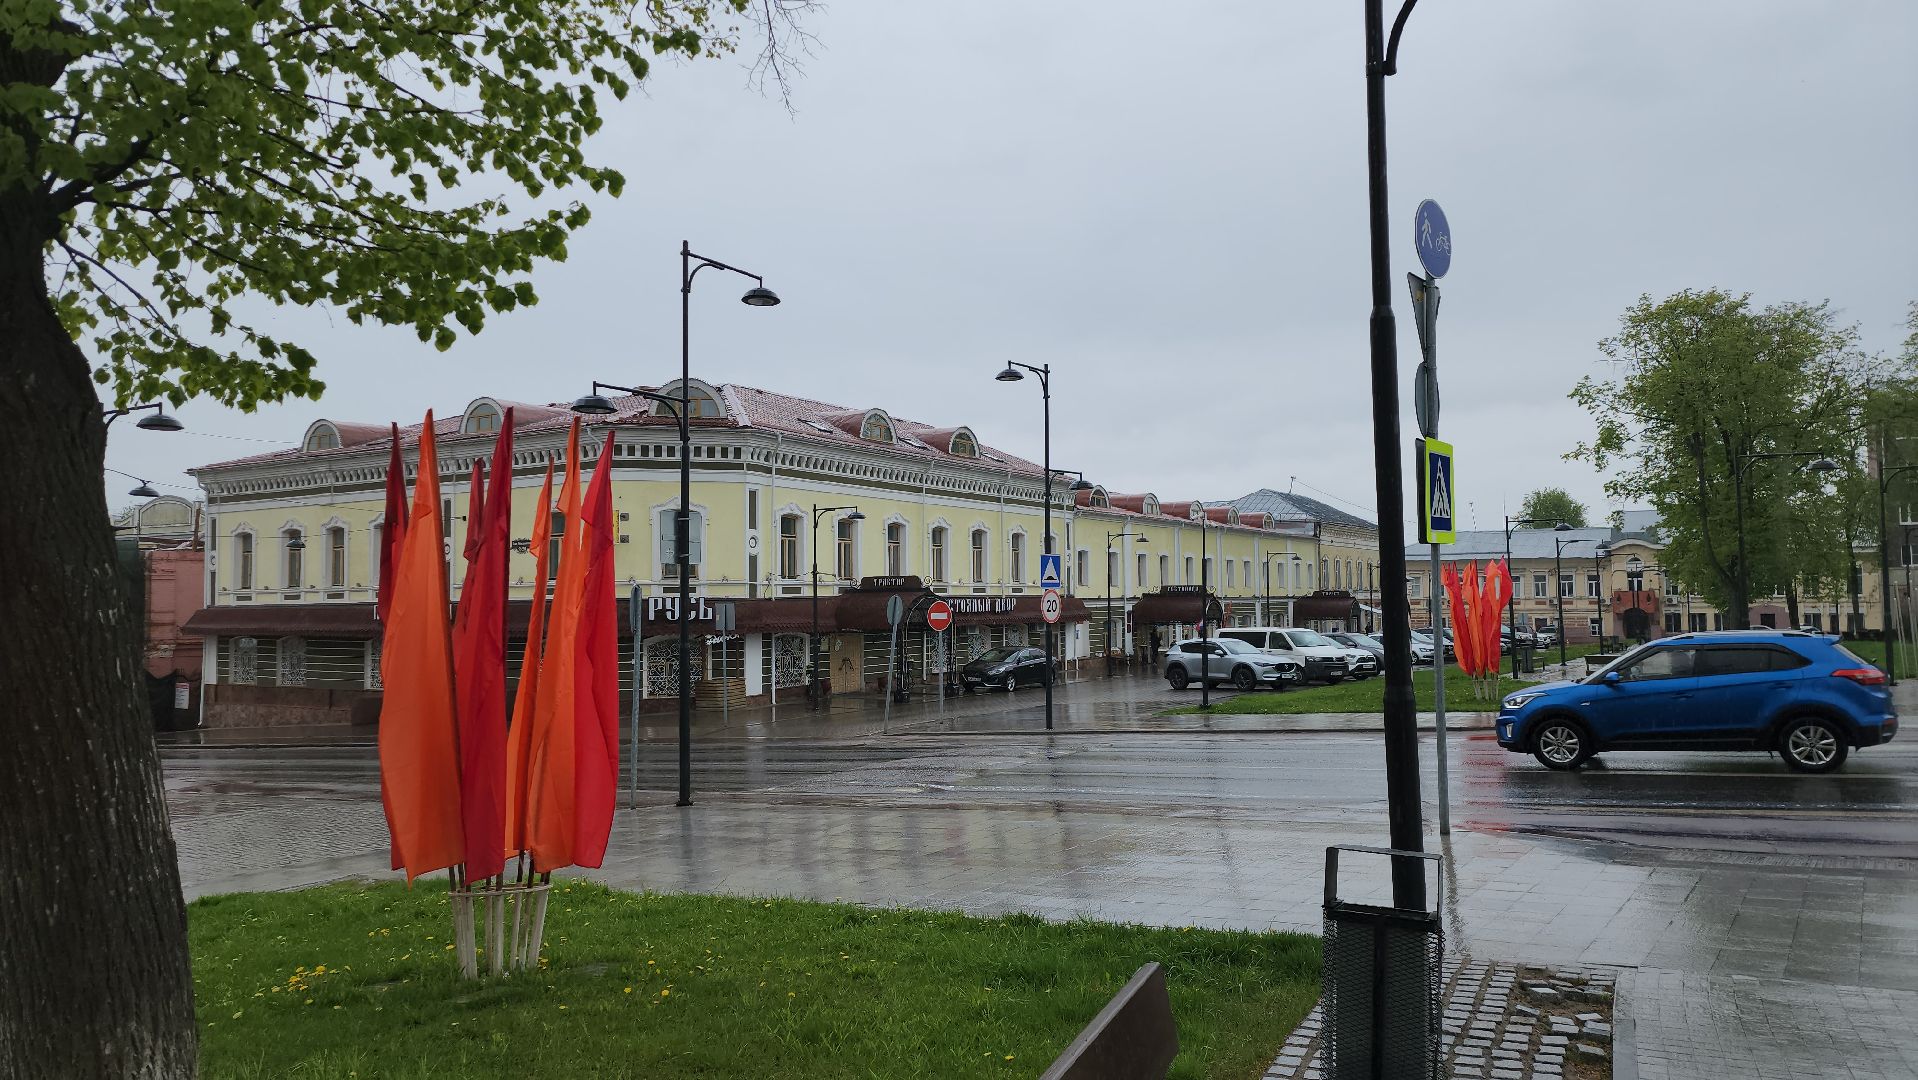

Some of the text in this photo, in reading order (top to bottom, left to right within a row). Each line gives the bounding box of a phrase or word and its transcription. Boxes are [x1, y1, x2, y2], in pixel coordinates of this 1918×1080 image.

[947, 597, 1017, 614] СТОЯЛЫЙ ДВОР
[1046, 599, 1058, 613] 20
